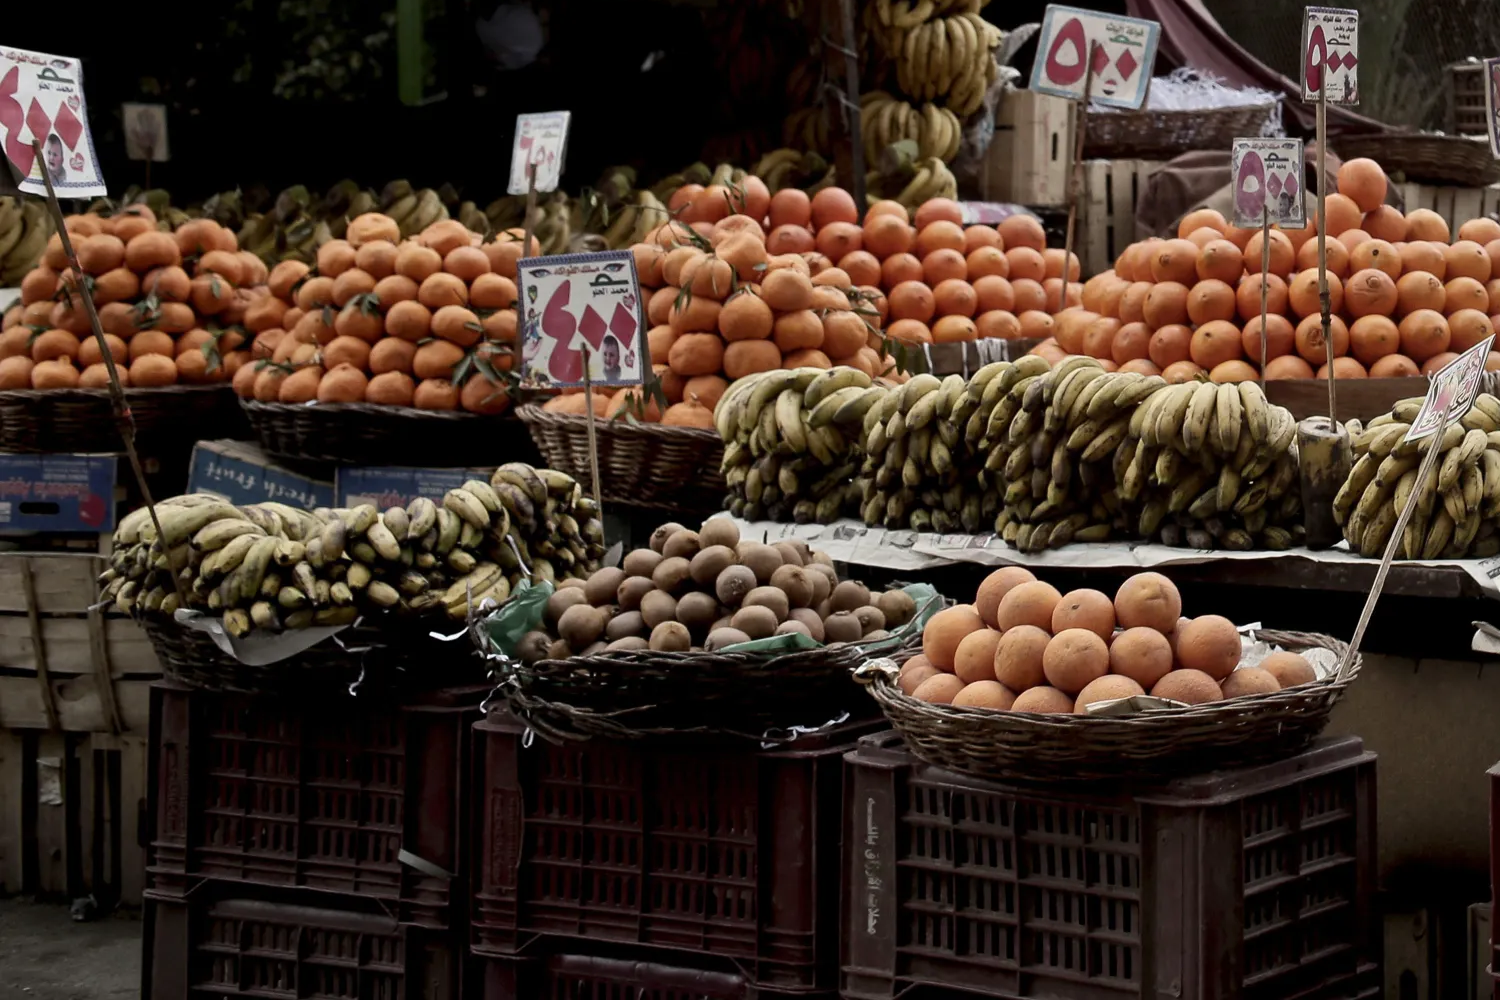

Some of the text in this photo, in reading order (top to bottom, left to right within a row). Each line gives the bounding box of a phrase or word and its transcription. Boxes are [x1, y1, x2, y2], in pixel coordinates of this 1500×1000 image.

[1045, 17, 1138, 86] ٥٠٠
[1306, 24, 1359, 93] ٥٠٠
[1236, 151, 1299, 218] ٥٠٠
[542, 279, 637, 384] ٤٠٠
[205, 460, 317, 509] fresh fruit
